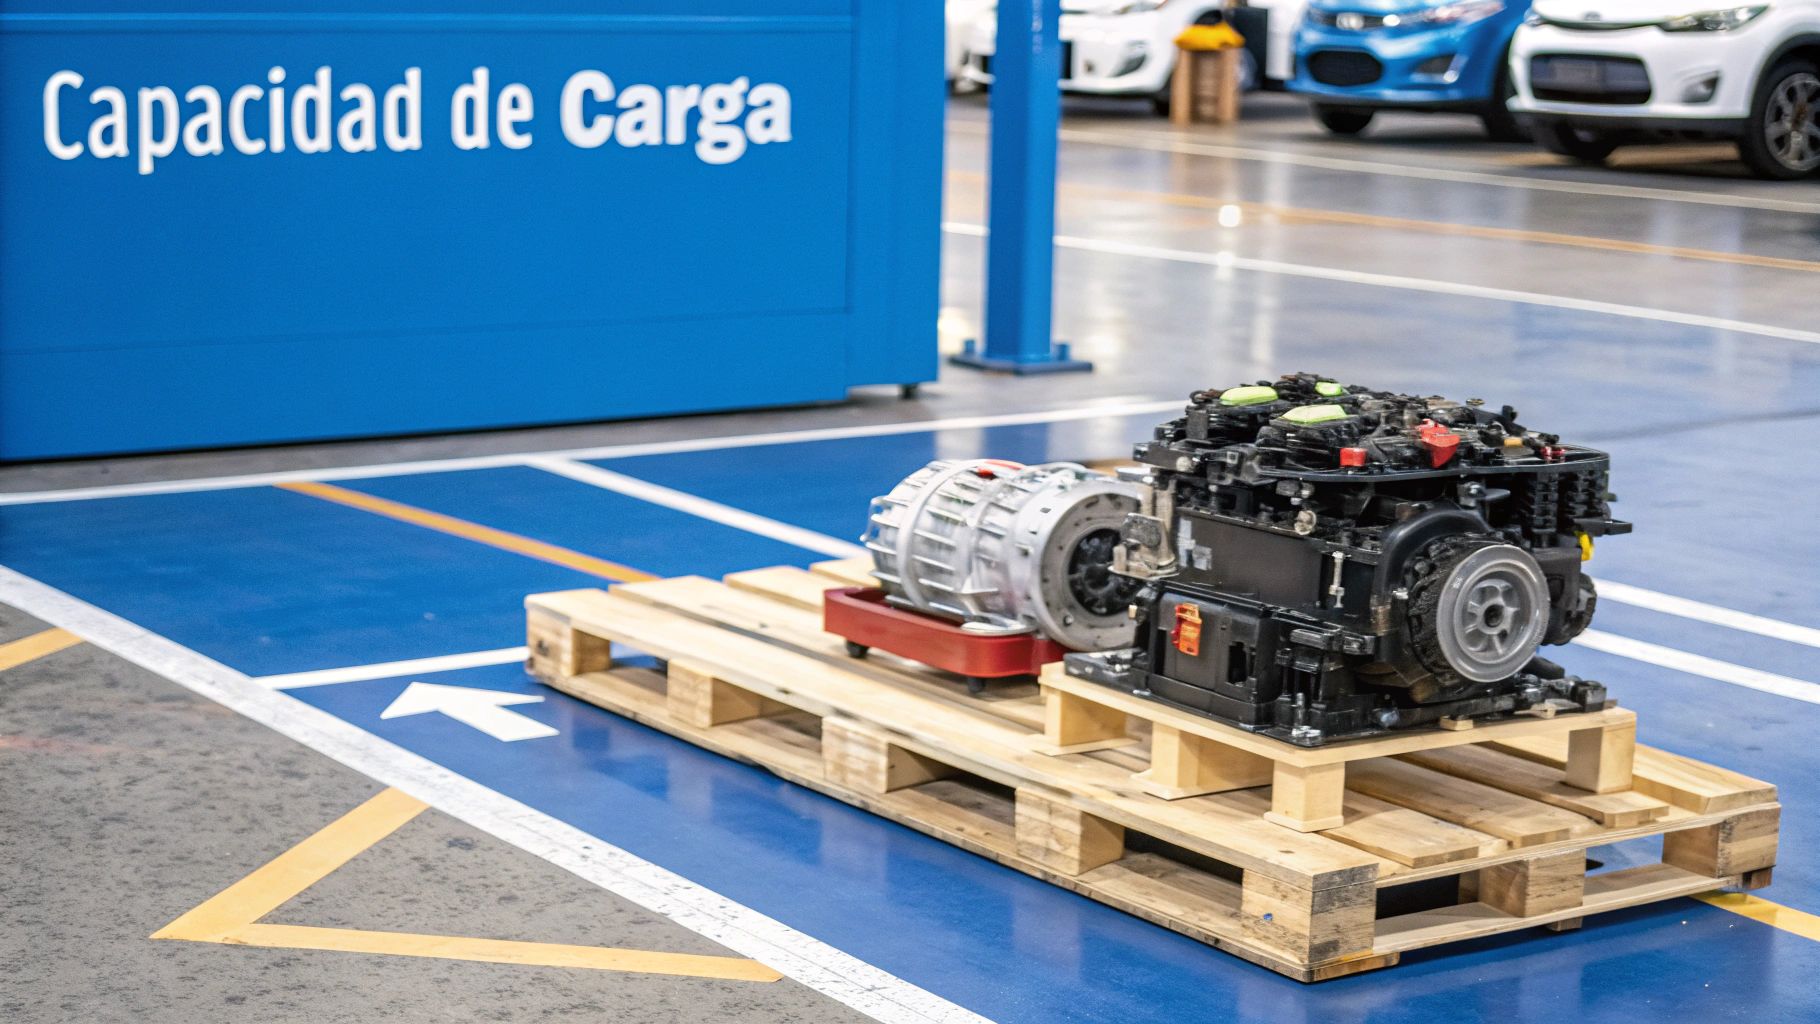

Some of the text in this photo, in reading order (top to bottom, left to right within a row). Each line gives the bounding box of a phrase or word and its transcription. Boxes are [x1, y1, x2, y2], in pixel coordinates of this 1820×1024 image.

[43, 66, 792, 175] Capacidad de Carga
